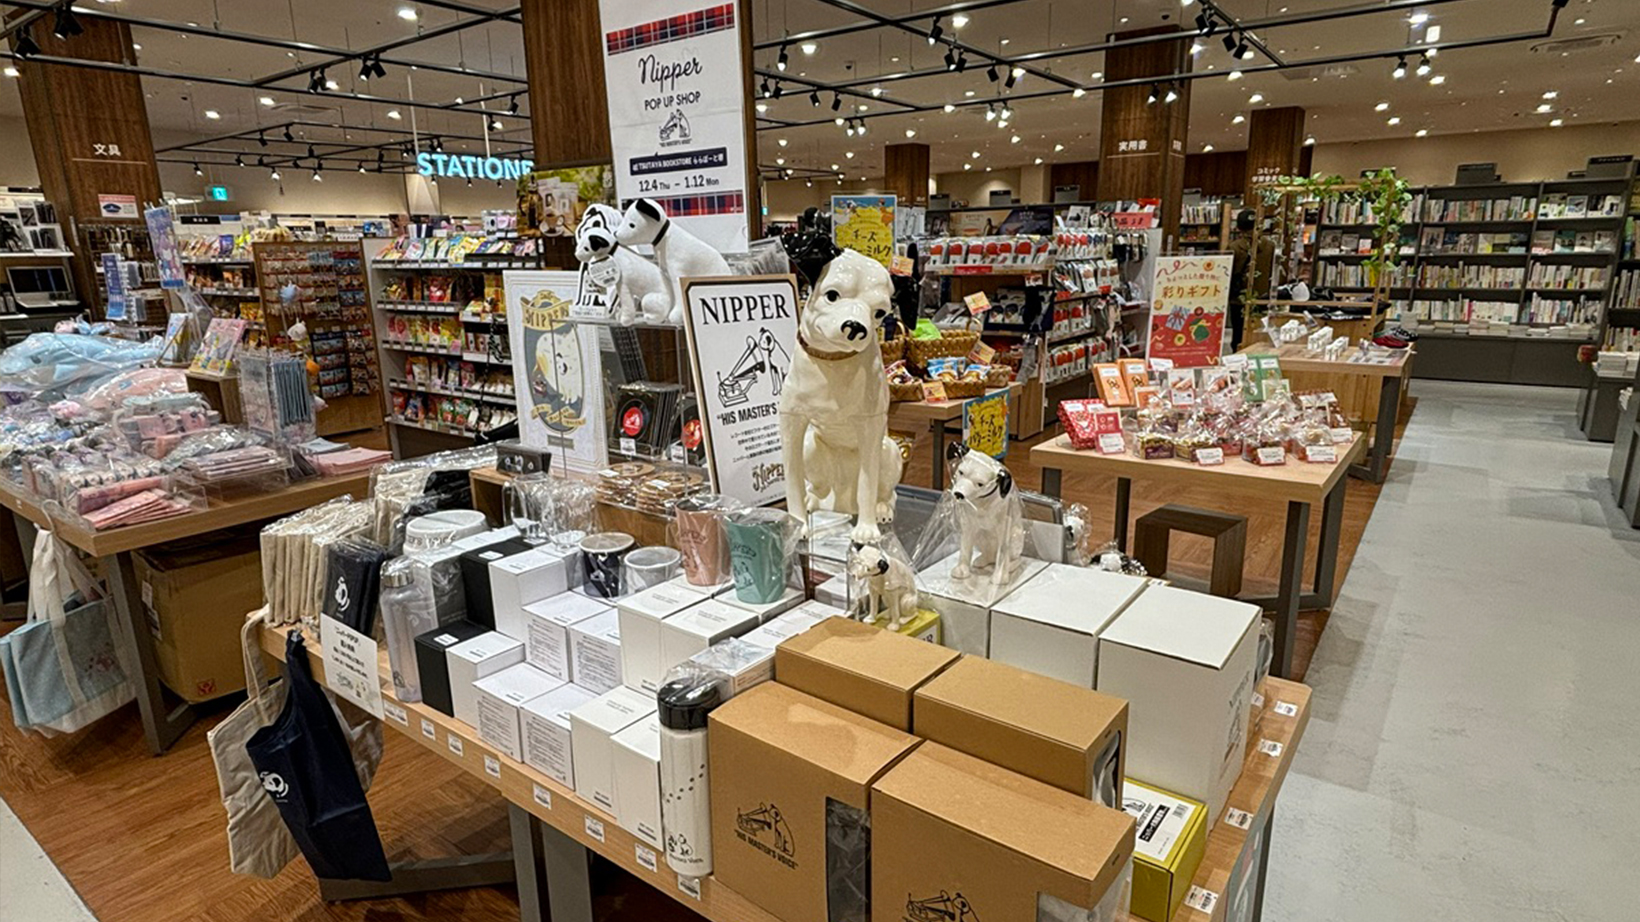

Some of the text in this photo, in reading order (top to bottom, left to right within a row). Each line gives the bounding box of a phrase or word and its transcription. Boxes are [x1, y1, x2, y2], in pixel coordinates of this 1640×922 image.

[638, 54, 703, 93] Nipper
[644, 91, 701, 111] POP UP SHOP
[93, 143, 121, 157] 文具
[1118, 139, 1147, 152] 実用書
[638, 161, 662, 170] TSUTAYA
[662, 157, 692, 168] BOOKSTORE
[639, 178, 658, 192] 12.4
[659, 182, 670, 190] Thu
[684, 174, 704, 188] 1.12
[705, 177, 720, 186] Mon
[1162, 284, 1221, 299] 彩りギフト
[699, 293, 791, 325] NIPPER
[738, 402, 778, 422] MASTER'S
